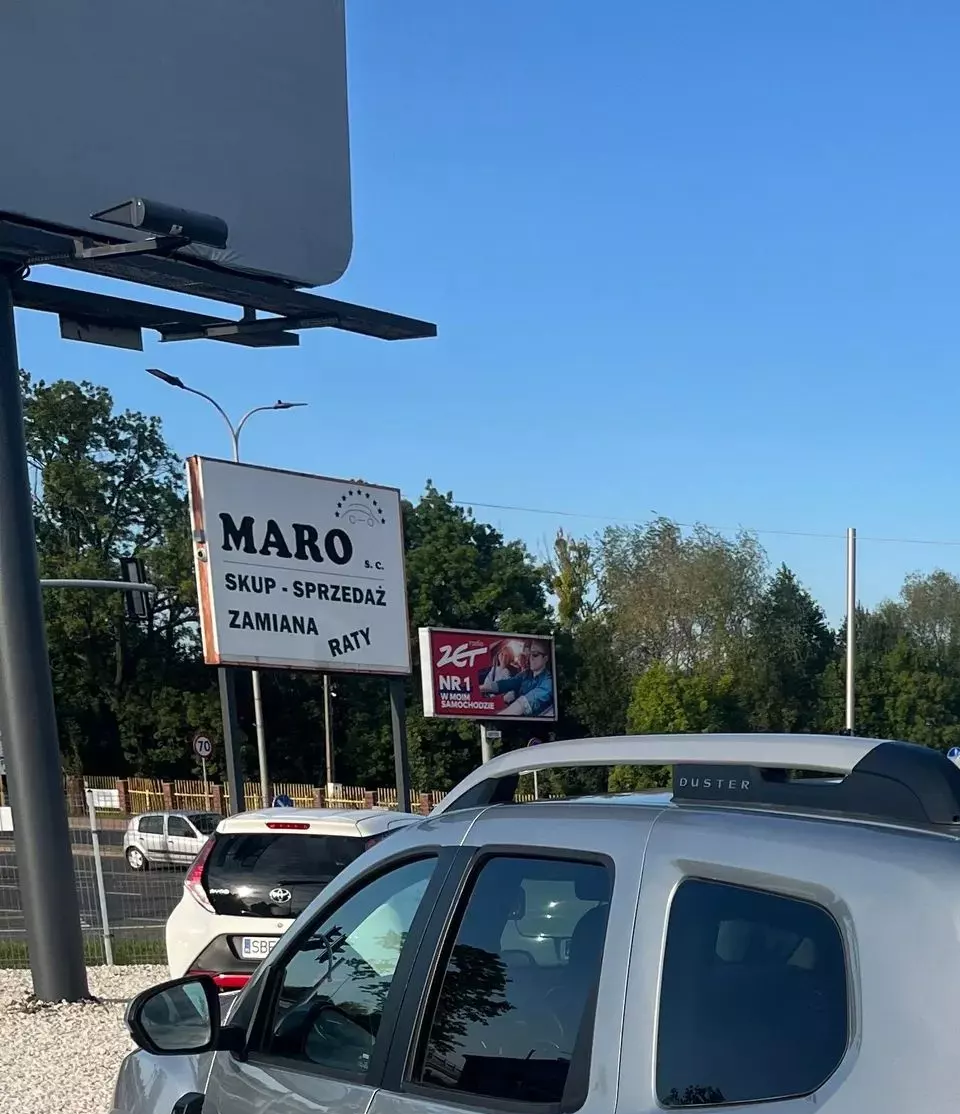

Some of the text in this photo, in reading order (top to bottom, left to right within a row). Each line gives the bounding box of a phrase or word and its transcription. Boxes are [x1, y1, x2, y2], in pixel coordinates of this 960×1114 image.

[219, 512, 353, 565] MARO
[225, 573, 277, 595] SKUP
[293, 580, 387, 606] SPRZEDAŻ
[228, 610, 319, 636] ZAMIANA
[328, 627, 372, 658] RATY
[439, 675, 471, 692] NR 1
[440, 692, 471, 702] W MOIM
[440, 701, 495, 710] SAMOCHODZIE
[198, 740, 210, 752] 70
[679, 777, 750, 790] DUSTER
